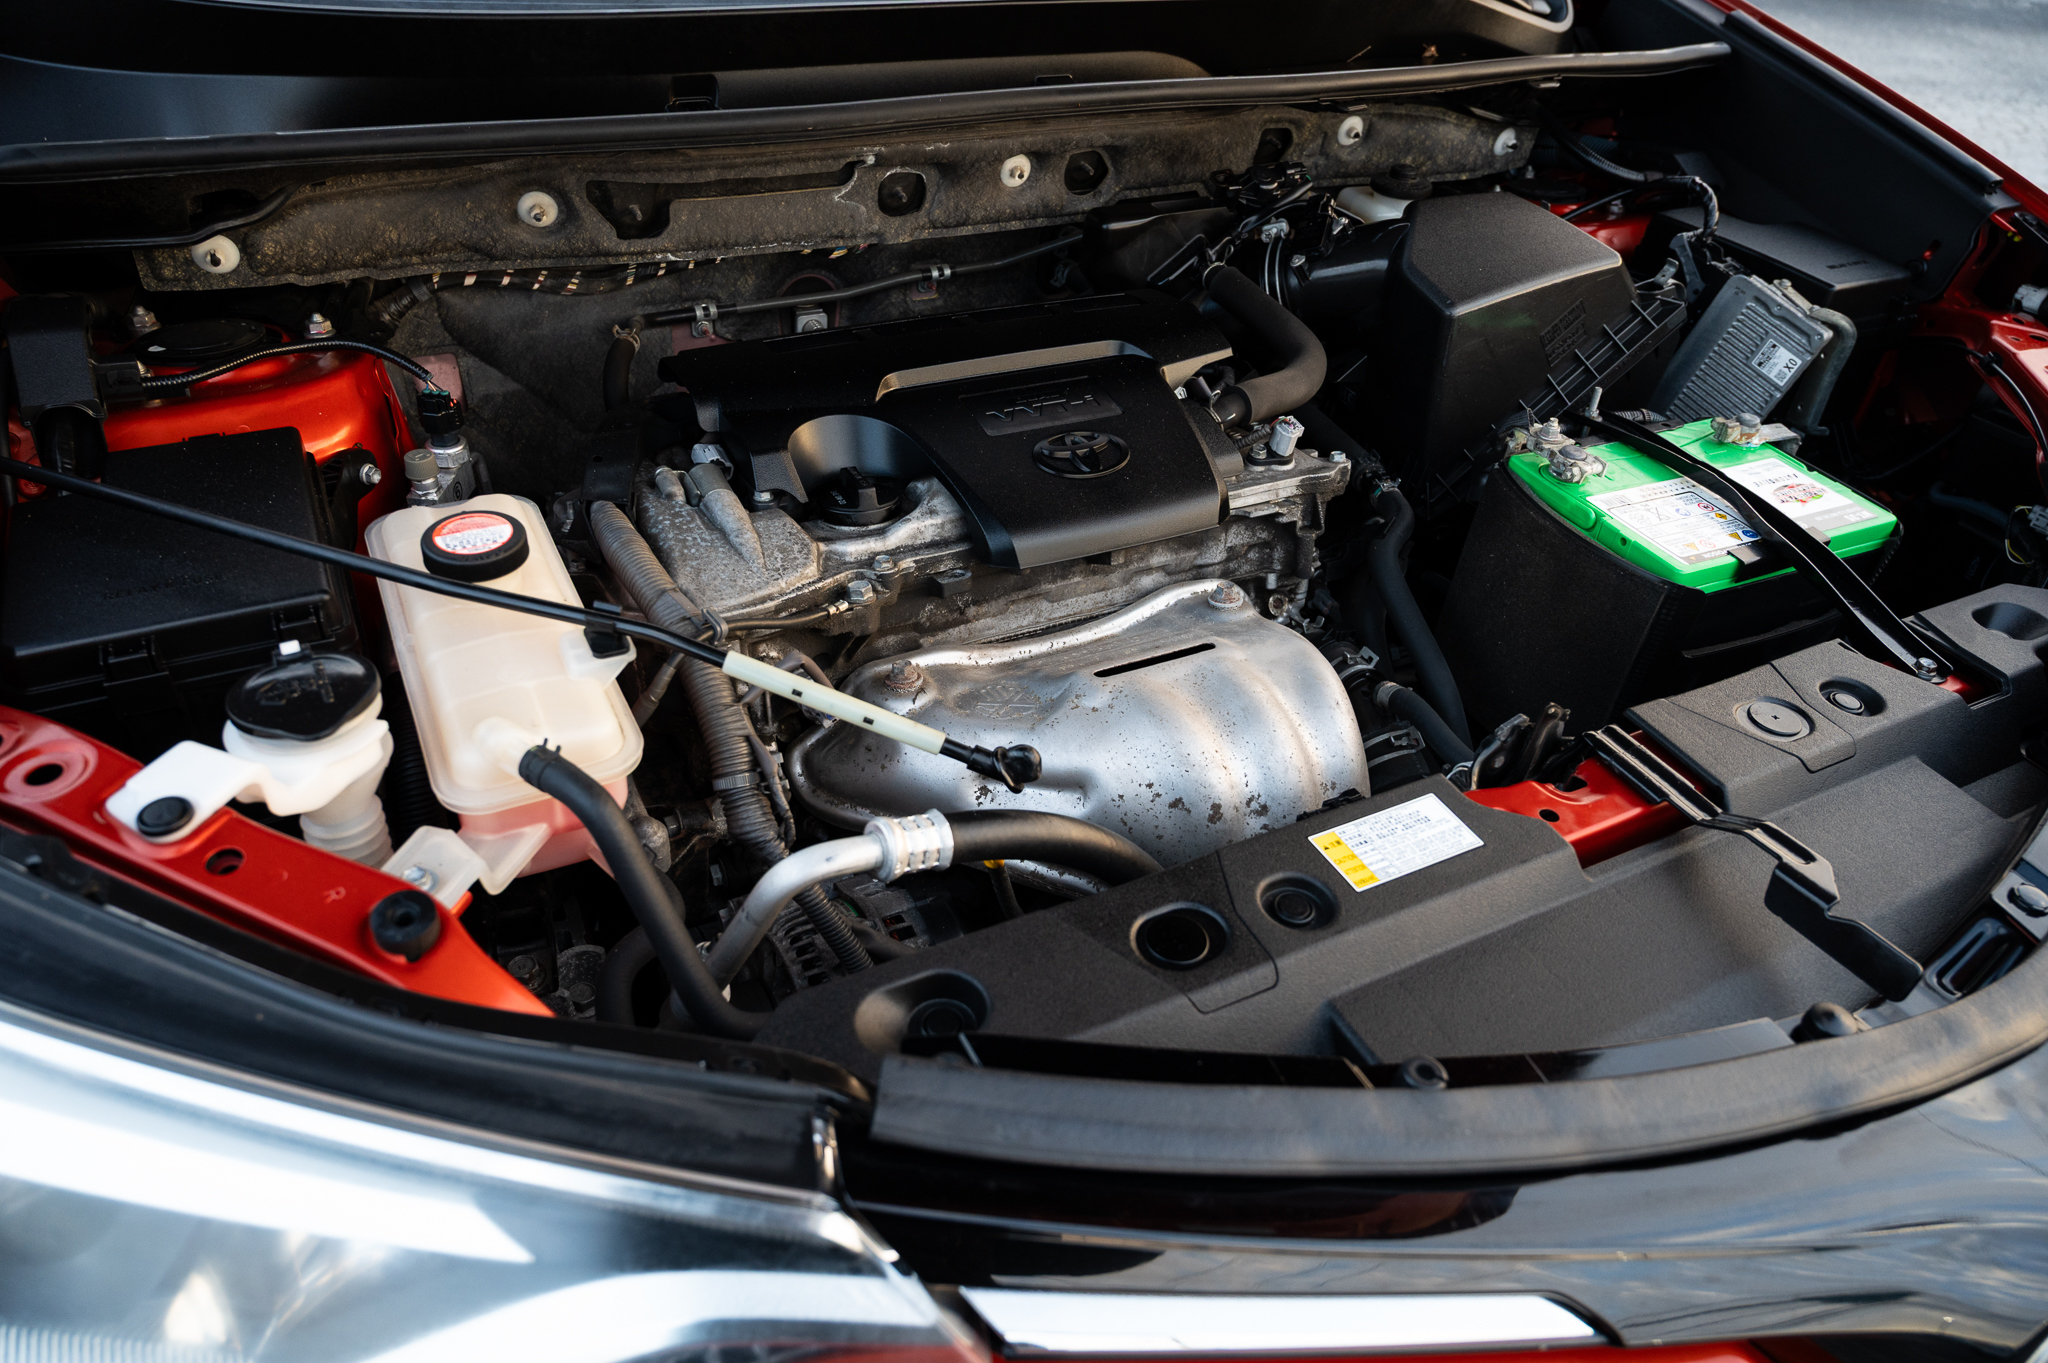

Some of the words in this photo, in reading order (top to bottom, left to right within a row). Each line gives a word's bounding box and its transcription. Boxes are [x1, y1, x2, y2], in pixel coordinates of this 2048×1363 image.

[1753, 473, 1798, 487] AUTOMOTIVE
[1773, 483, 1816, 497] BATTERIES
[1780, 487, 1827, 503] INTERSTATE
